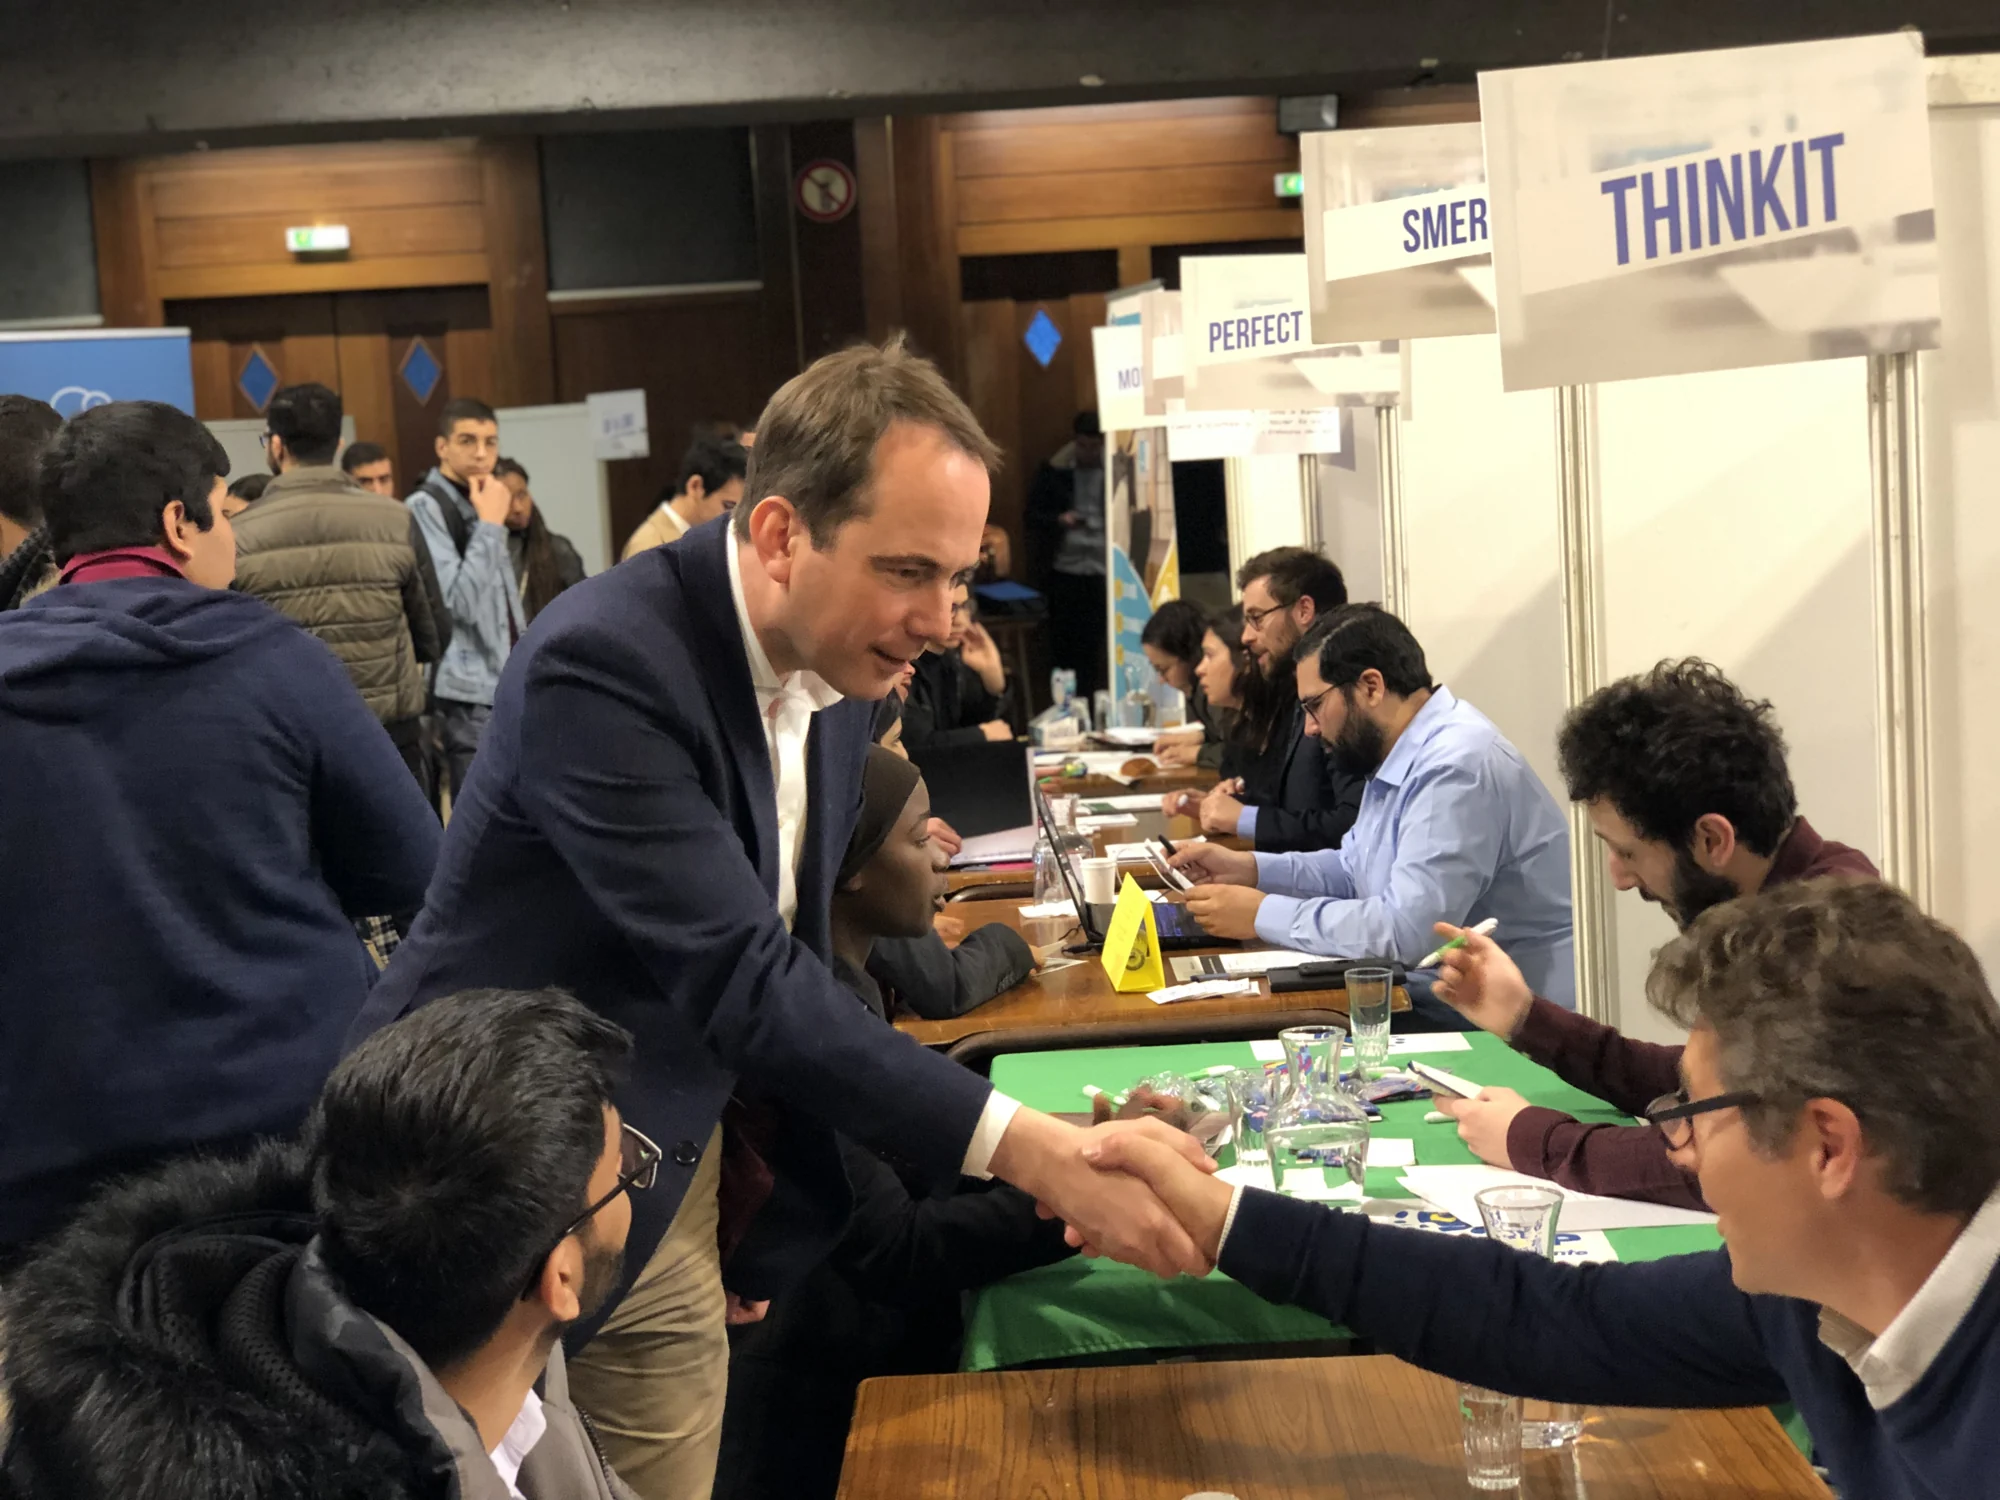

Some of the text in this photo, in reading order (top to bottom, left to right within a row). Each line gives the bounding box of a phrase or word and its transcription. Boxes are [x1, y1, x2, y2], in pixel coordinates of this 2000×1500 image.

[1402, 197, 1488, 253] SMER
[1601, 132, 1845, 266] THINKIT
[1209, 310, 1304, 353] PERFECT
